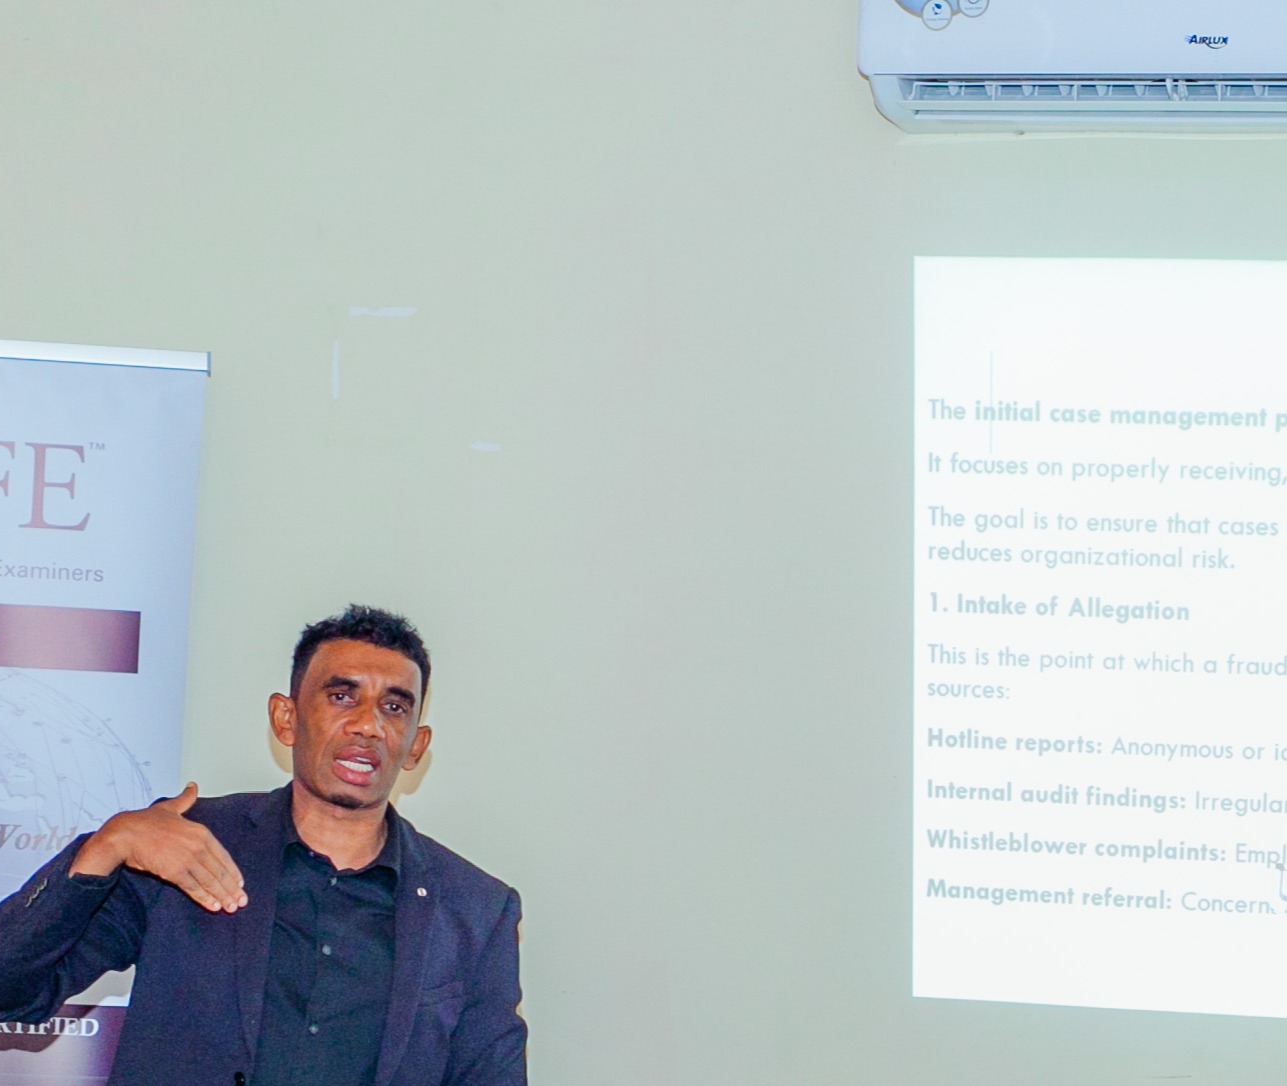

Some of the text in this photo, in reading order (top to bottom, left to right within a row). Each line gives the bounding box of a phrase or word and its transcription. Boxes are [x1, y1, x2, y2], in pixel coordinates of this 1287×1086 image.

[928, 398, 967, 421] The
[975, 400, 1041, 424] initial
[1049, 407, 1102, 424] case
[1109, 408, 1268, 432] management
[928, 452, 942, 473] It
[950, 452, 1029, 476] focuses
[1036, 461, 1063, 477] on
[1071, 457, 1170, 484] properly
[1180, 462, 1287, 487] receiving,
[928, 505, 966, 527] The
[974, 508, 1024, 533] goal
[1034, 511, 1048, 530] is
[1056, 513, 1078, 531] to
[1086, 517, 1158, 533] ensure
[1166, 512, 1210, 535] that
[1218, 520, 1279, 537] cases
[928, 540, 1235, 569] reduces organizational risk.
[930, 592, 1190, 624] 1. Intake of Allegation
[927, 643, 966, 665] This
[975, 648, 990, 666] is
[997, 646, 1030, 668] the
[1039, 651, 1094, 672] point
[1102, 654, 1125, 670] at
[1133, 651, 1194, 673] which
[1203, 660, 1217, 674] a
[927, 682, 1009, 699] sources:
[927, 727, 1008, 751] Hotline
[1015, 736, 1102, 757] reports:
[1111, 737, 1234, 762] Anonymous
[1242, 746, 1265, 760] or
[927, 778, 1012, 802] Internal
[1020, 784, 1079, 805] audit
[1086, 785, 1186, 814] findings:
[926, 828, 1087, 856] Whistleblower
[1094, 838, 1226, 863] complaints:
[926, 878, 1075, 906] Management
[1082, 886, 1172, 910] referral:
